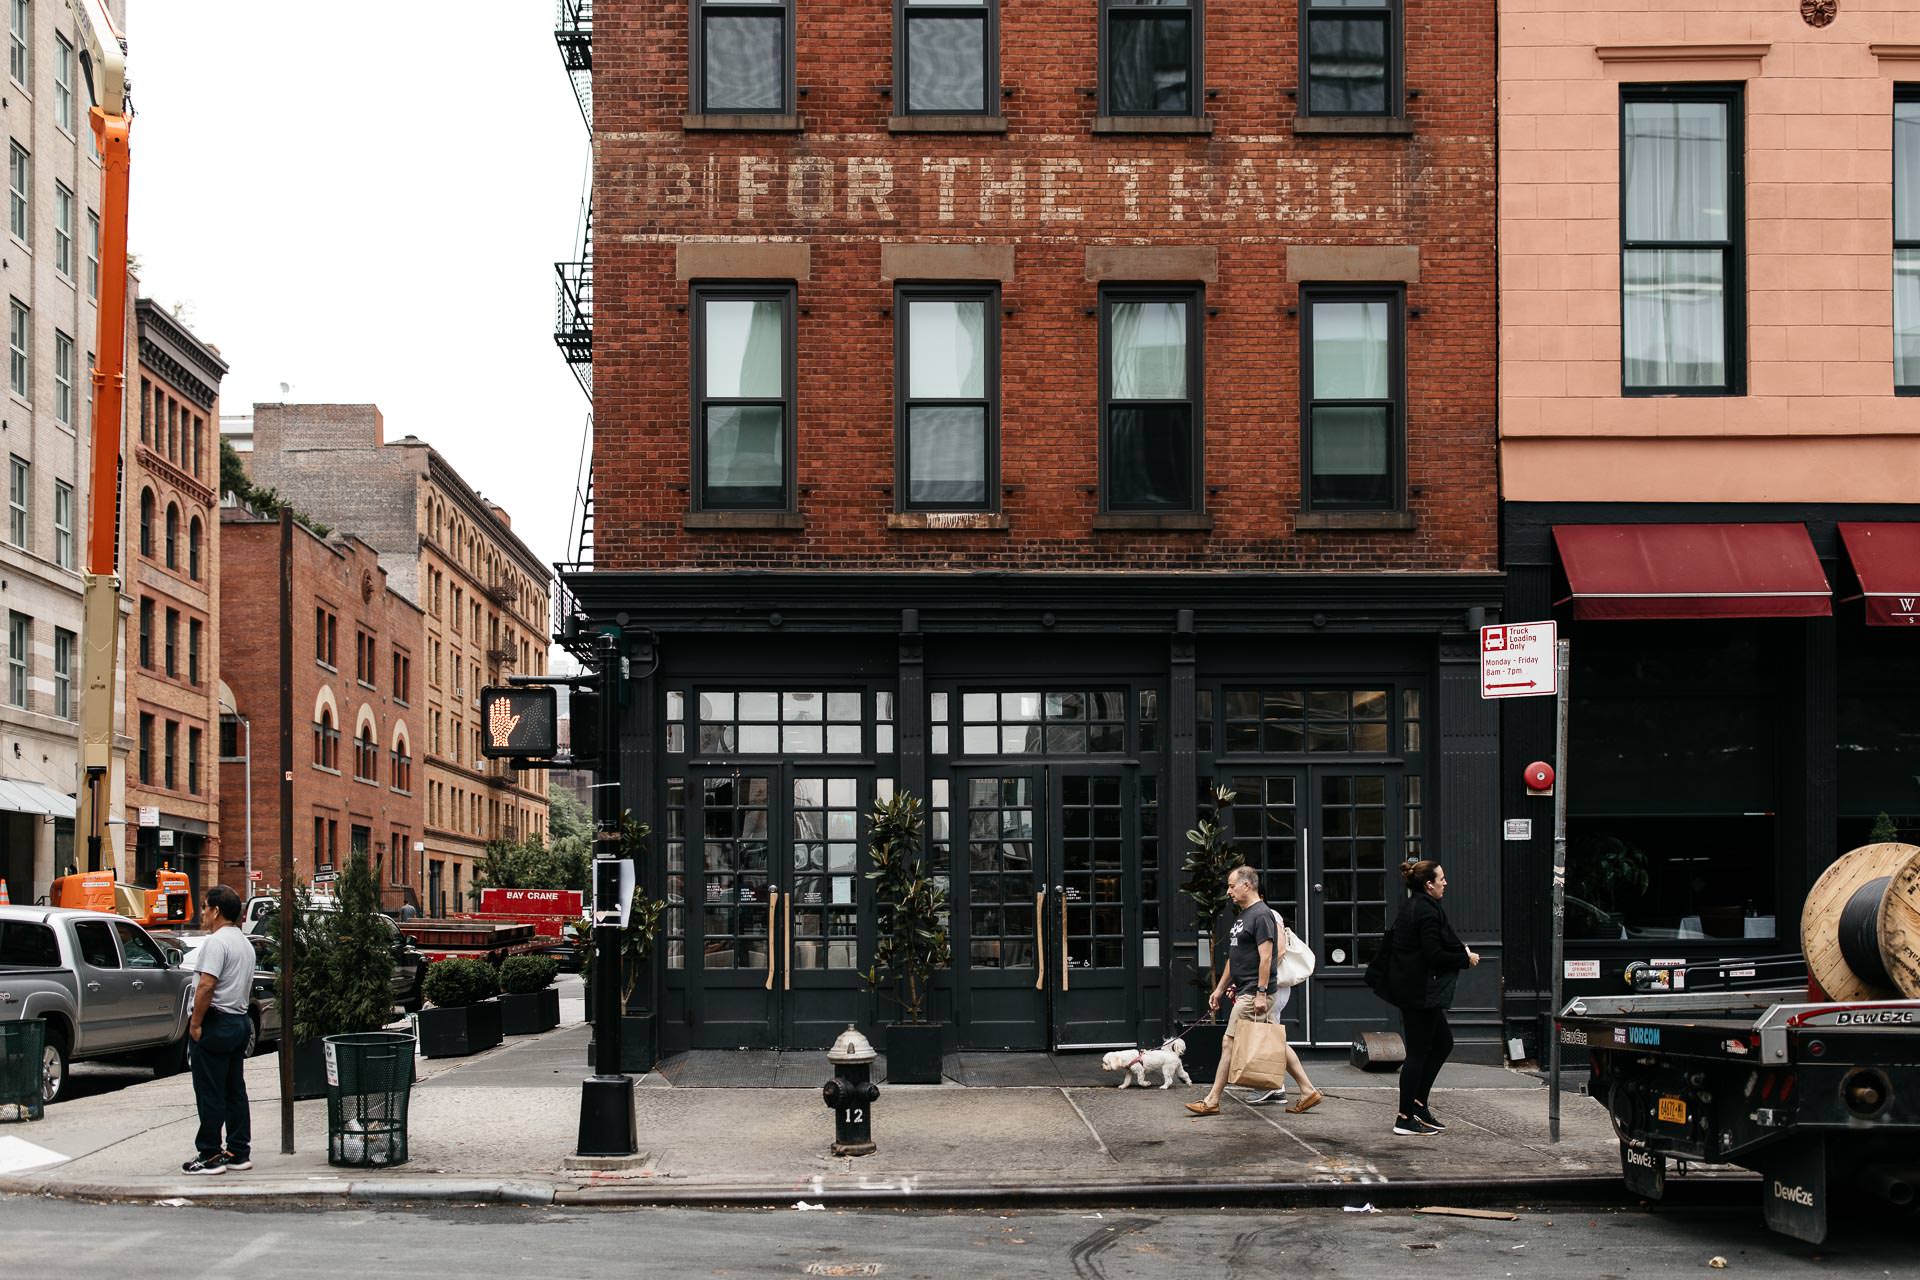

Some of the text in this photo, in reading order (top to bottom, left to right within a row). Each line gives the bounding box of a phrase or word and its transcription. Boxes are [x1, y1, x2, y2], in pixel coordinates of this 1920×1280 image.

[738, 156, 1390, 221] FOR THE TRADE.
[1518, 656, 1539, 664] Friday
[1486, 668, 1501, 676] 8am
[1508, 668, 1522, 676] 7pm
[527, 892, 559, 900] CRANE
[1629, 1026, 1660, 1045] VORCOM
[845, 1108, 863, 1123] 12
